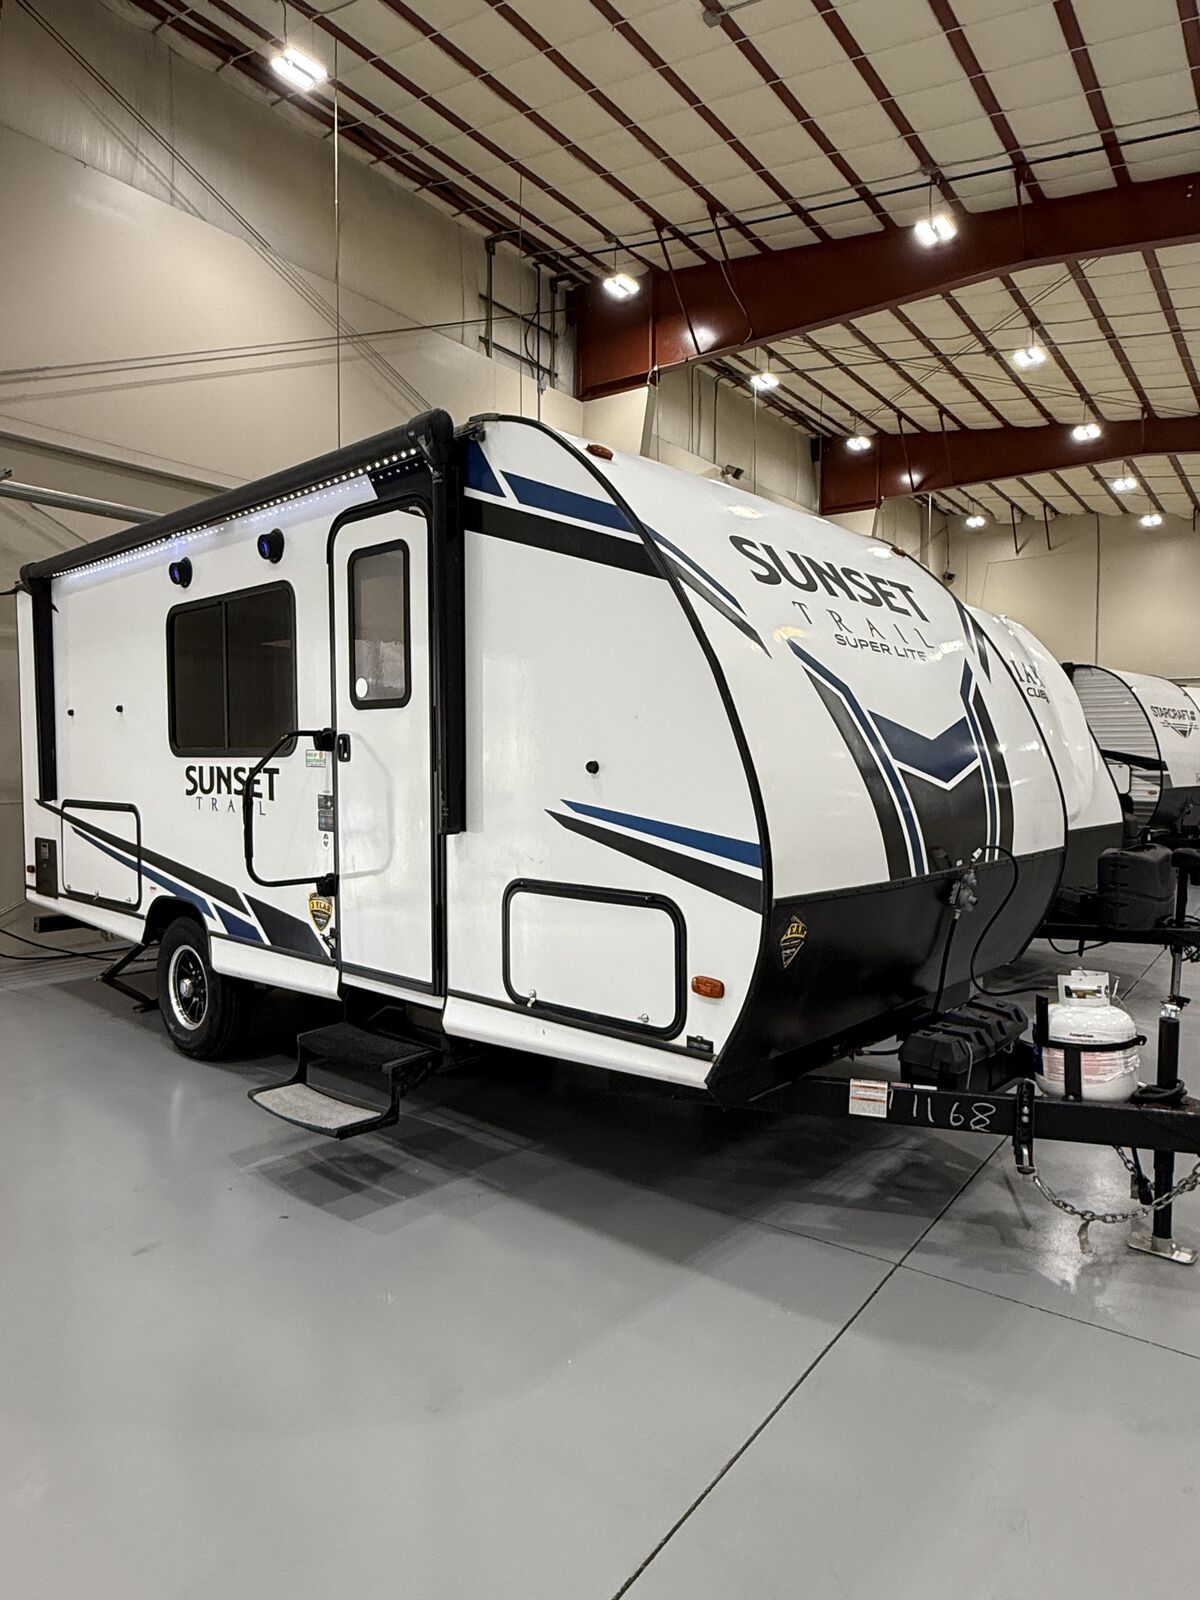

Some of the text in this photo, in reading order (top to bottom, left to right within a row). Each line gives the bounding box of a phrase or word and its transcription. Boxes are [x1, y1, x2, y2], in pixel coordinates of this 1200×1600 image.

[729, 535, 930, 623] SUNSET
[792, 600, 935, 649] TRAIL
[834, 634, 928, 661] SUPER LITE
[1150, 705, 1190, 720] STARCRAFT
[185, 765, 280, 802] SUNSET
[196, 796, 266, 816] TRAL
[785, 924, 806, 937] EAR
